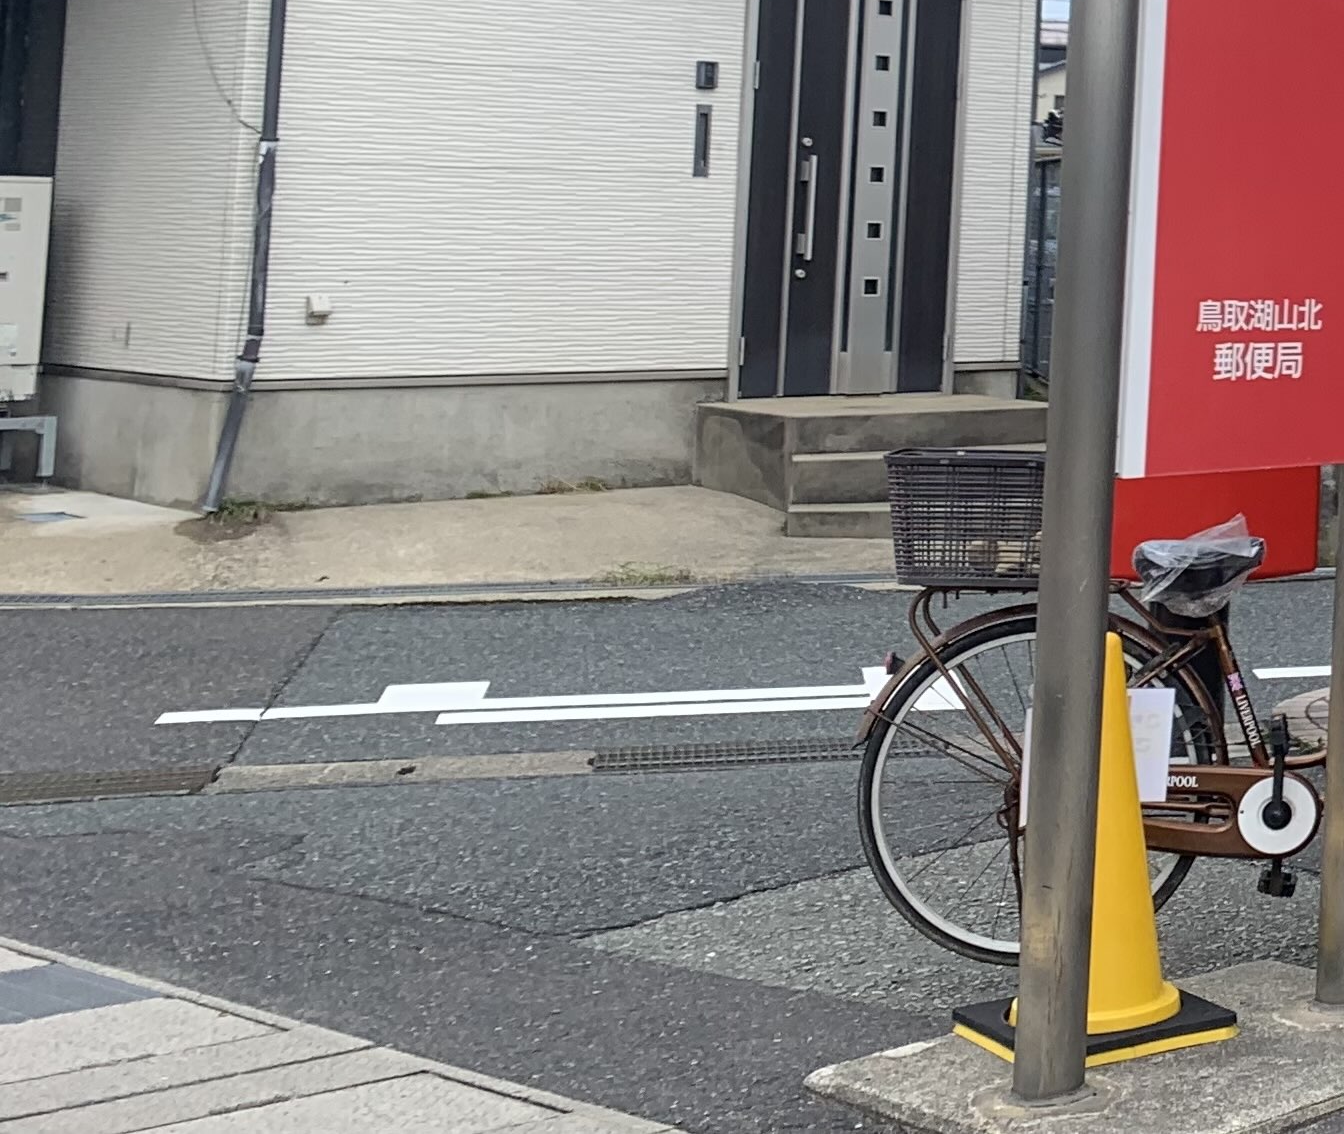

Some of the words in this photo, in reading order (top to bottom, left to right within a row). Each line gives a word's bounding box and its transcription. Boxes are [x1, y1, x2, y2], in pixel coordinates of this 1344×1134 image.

[1196, 299, 1323, 332] 鳥取湖山北
[1213, 342, 1303, 380] 郵便局
[1235, 694, 1262, 749] LIVERPOOL
